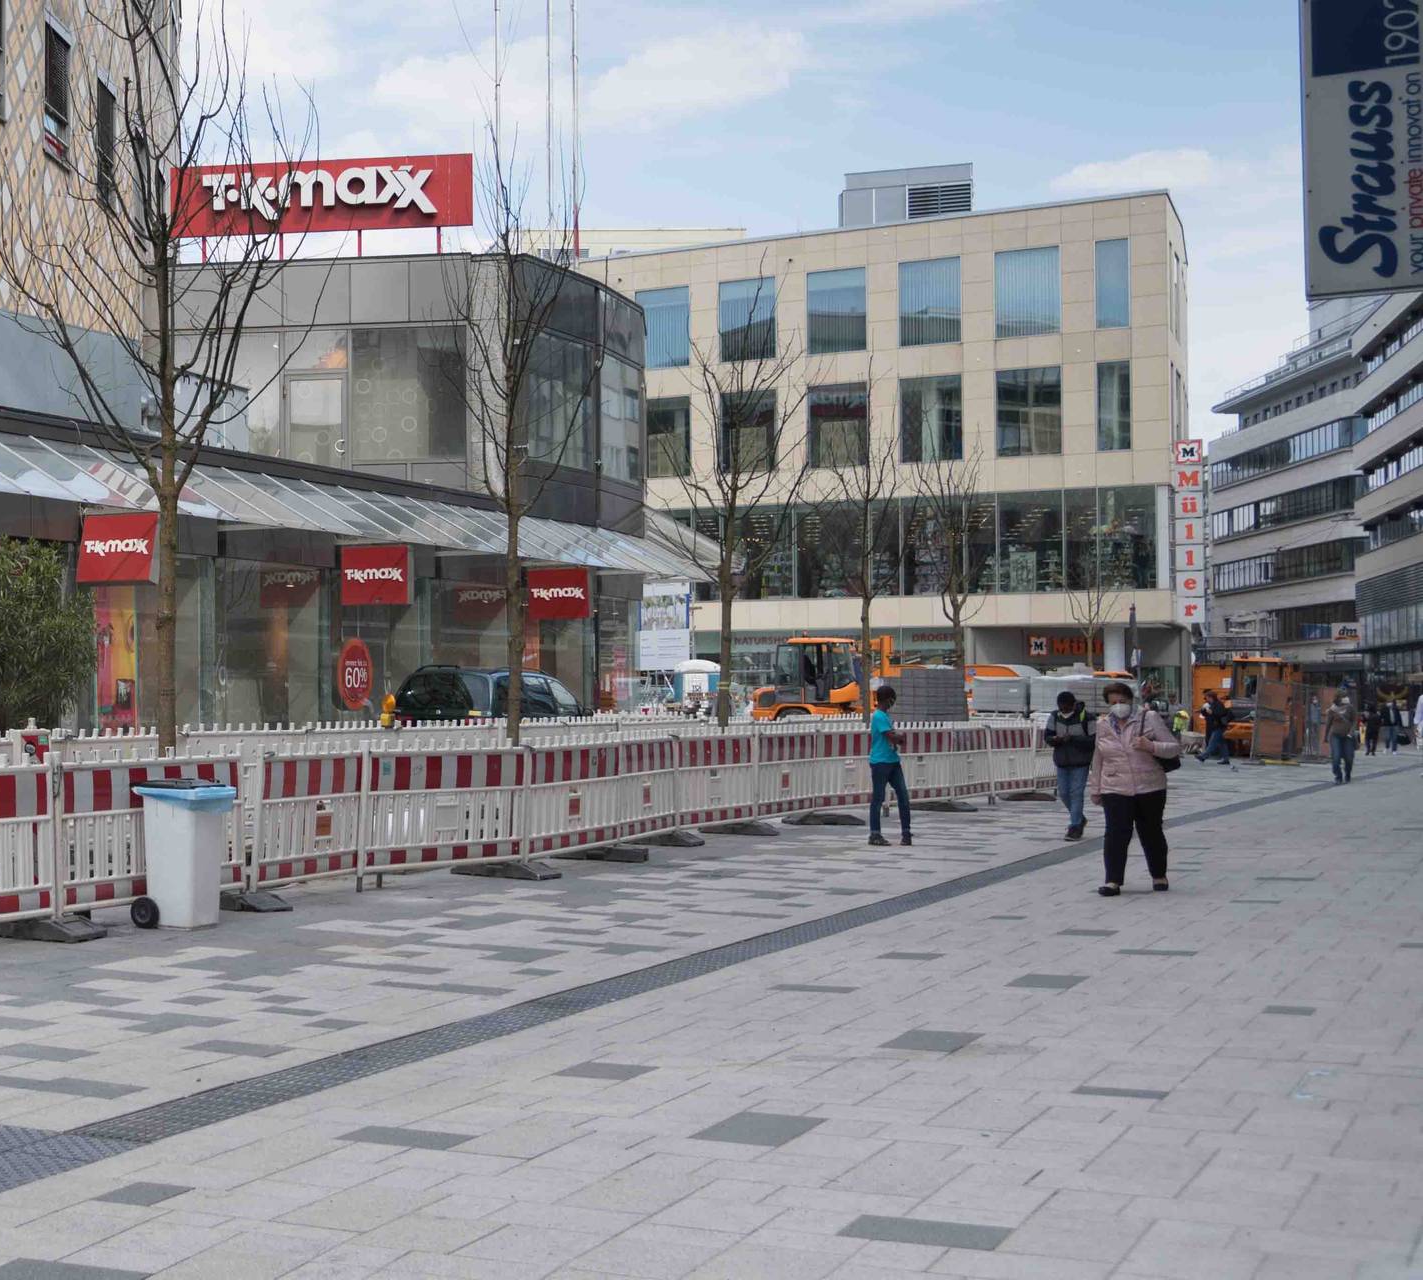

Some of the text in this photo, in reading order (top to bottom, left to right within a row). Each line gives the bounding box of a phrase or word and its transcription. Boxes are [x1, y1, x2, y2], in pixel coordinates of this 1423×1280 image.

[1318, 80, 1398, 279] Strauss
[1399, 72, 1423, 276] your private innovaton
[1181, 447, 1195, 458] M
[1177, 470, 1200, 617] Müller
[1338, 626, 1358, 637] dm
[1033, 640, 1044, 651] M
[345, 667, 368, 688] 60%
